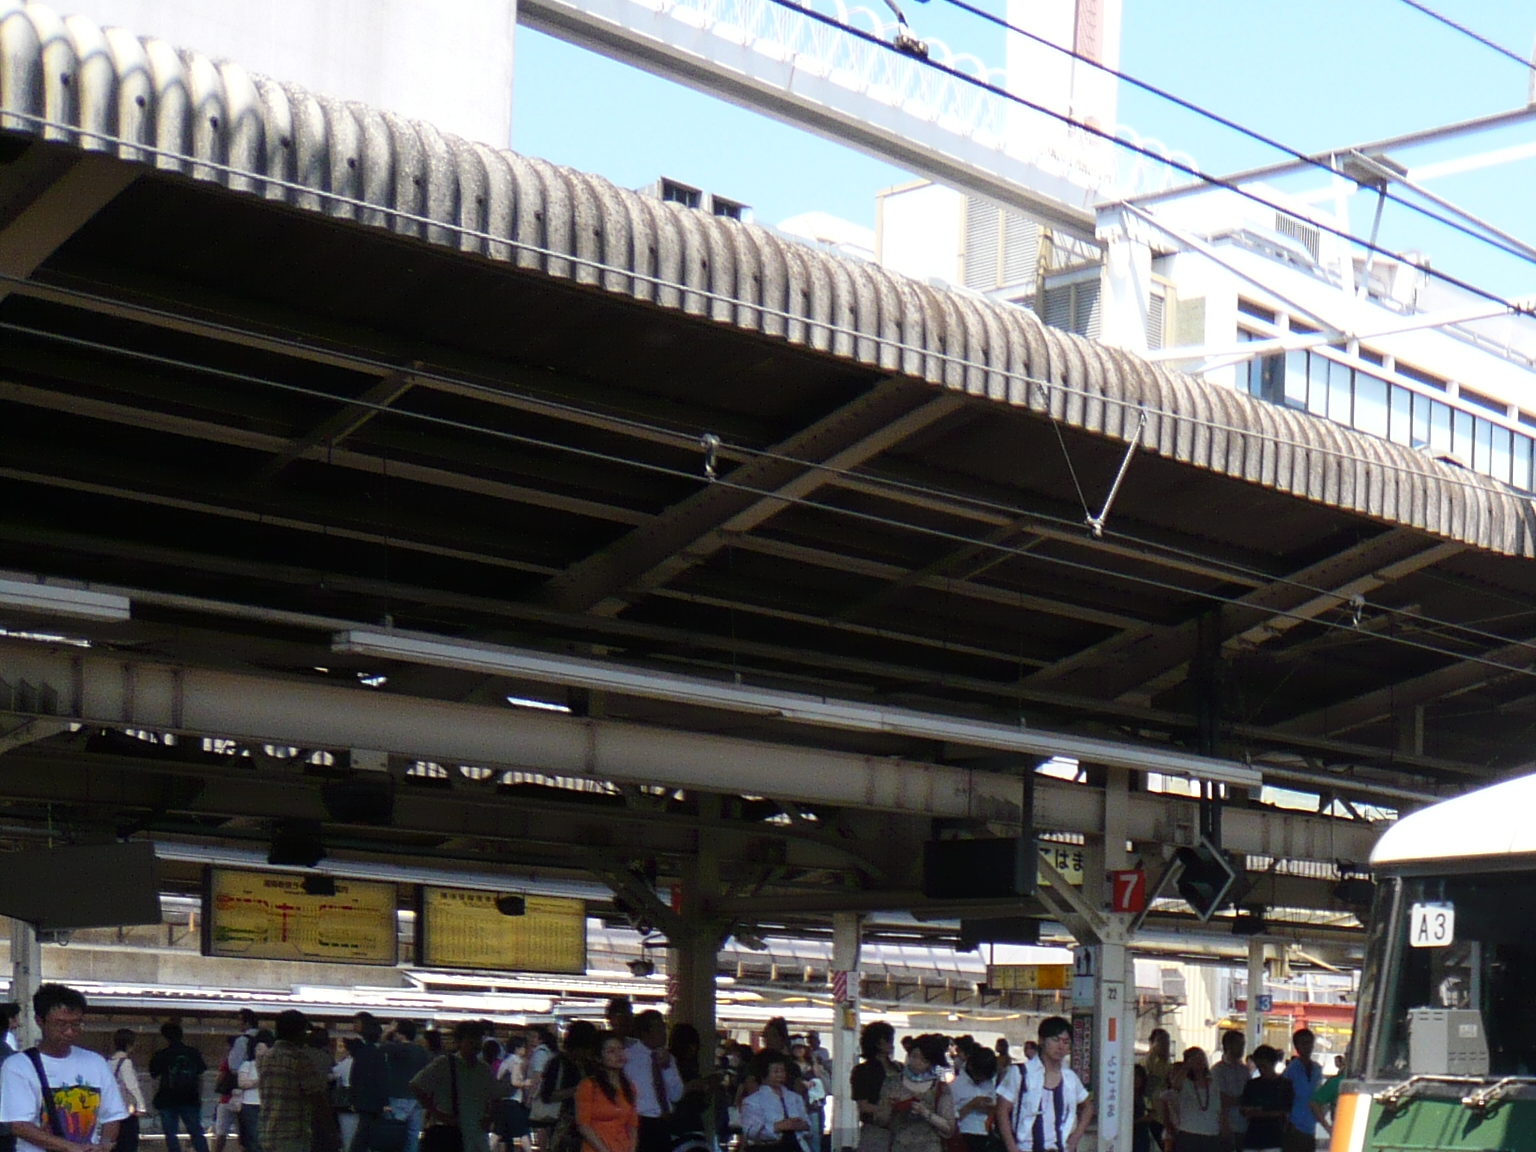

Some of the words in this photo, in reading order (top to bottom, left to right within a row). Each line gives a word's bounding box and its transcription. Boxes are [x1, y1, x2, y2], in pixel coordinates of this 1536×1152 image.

[1119, 873, 1139, 909] 7
[1418, 913, 1446, 942] A3
[1260, 996, 1271, 1011] 3
